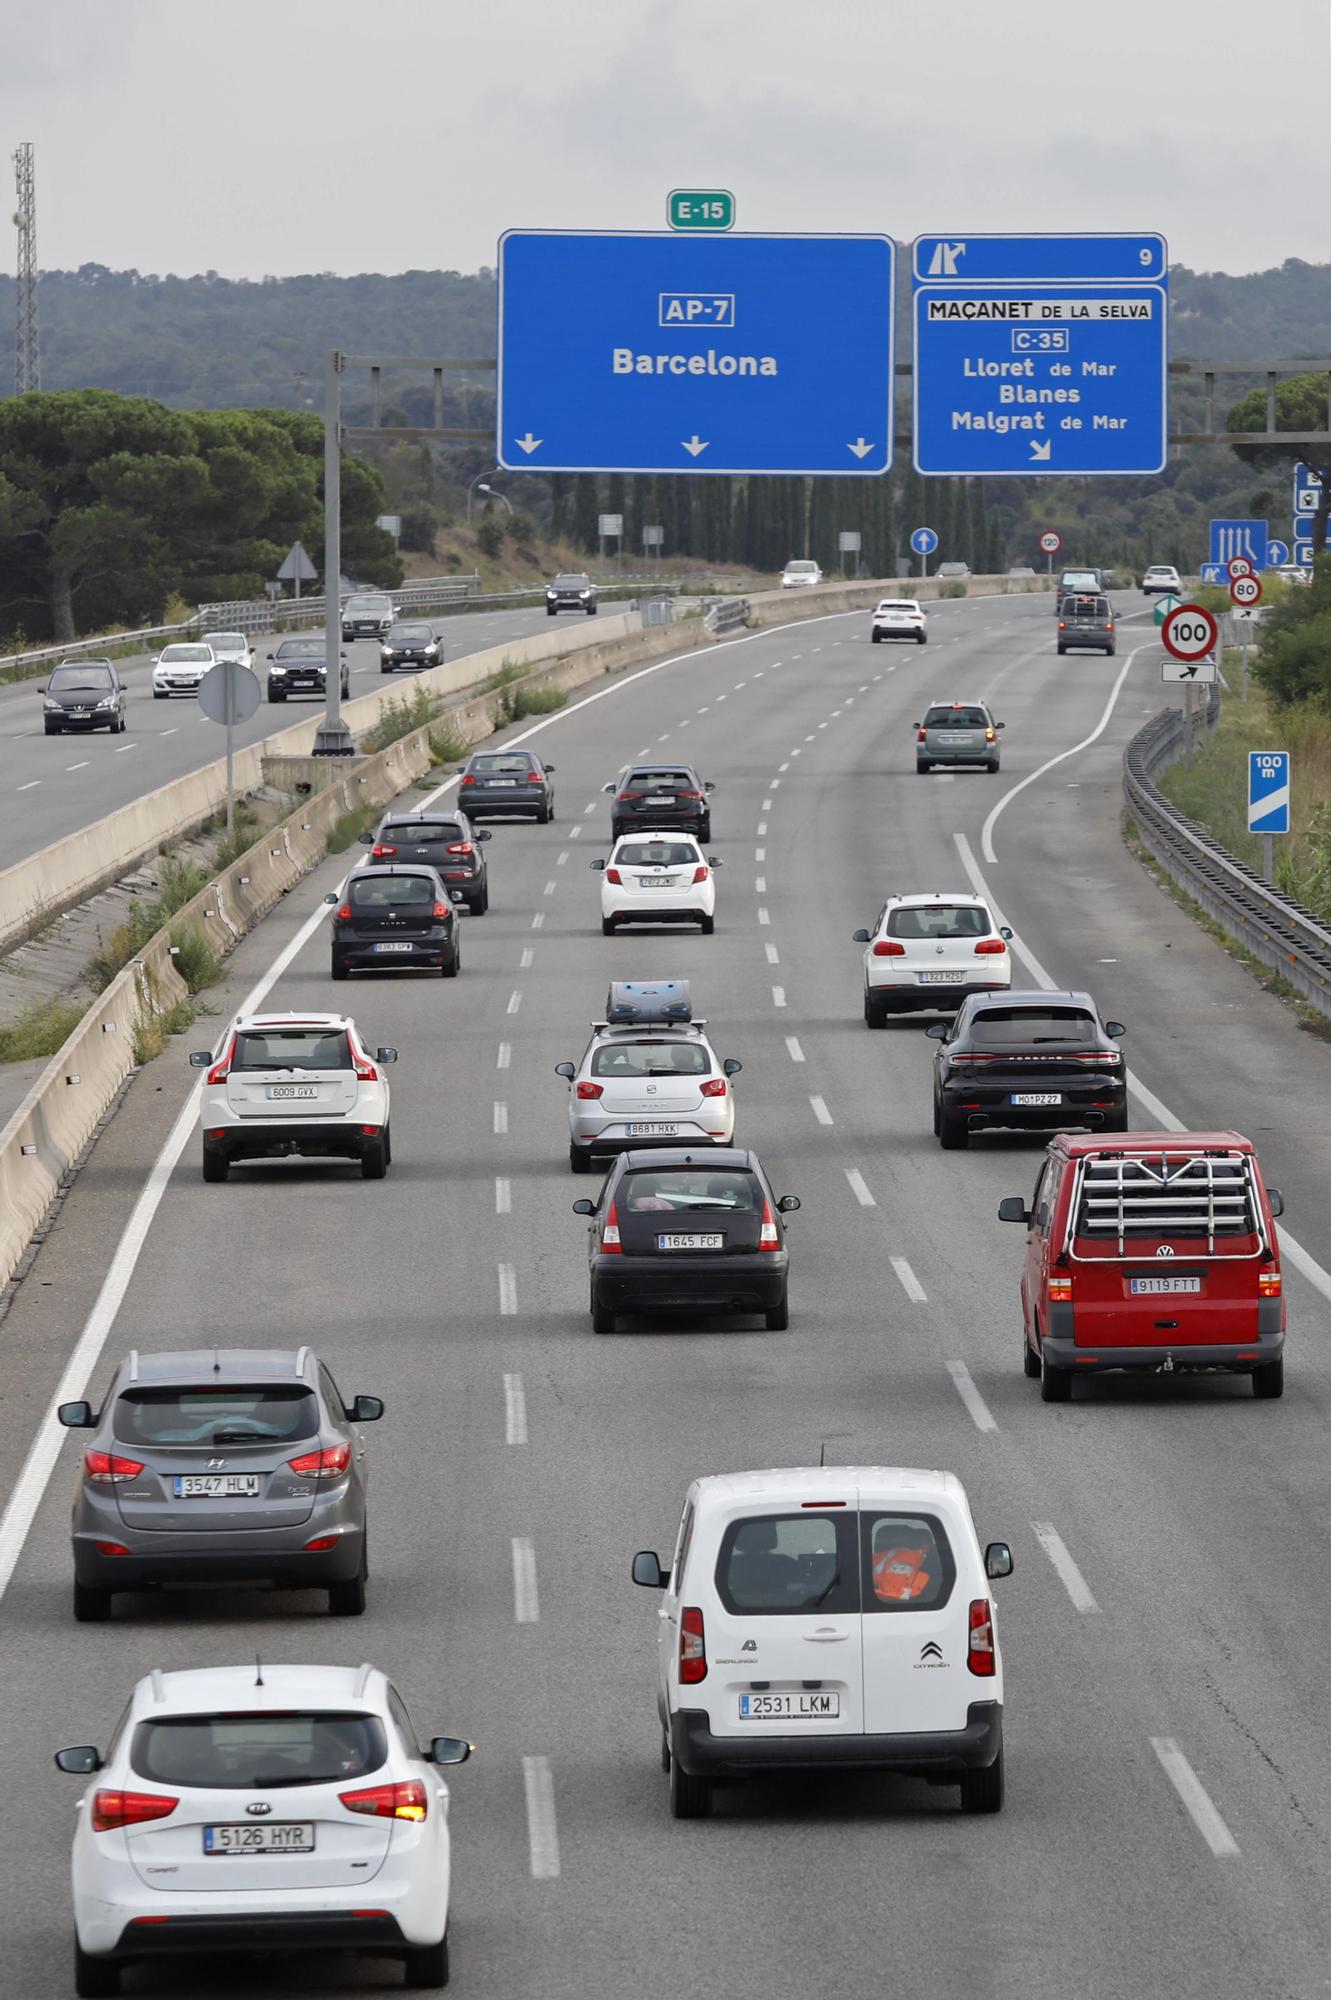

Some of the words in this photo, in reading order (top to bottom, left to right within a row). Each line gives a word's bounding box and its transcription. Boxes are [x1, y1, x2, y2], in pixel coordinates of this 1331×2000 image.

[678, 201, 724, 219] E-15
[1139, 248, 1152, 266] 9
[665, 300, 729, 321] AP-7
[930, 301, 1033, 321] MAÇANET
[1042, 306, 1062, 318] DE
[1070, 306, 1090, 318] LA
[1099, 305, 1149, 318] SELVA
[1016, 333, 1064, 349] C-35
[613, 348, 778, 376] Barcelona
[963, 358, 1034, 377] Lloret
[1049, 363, 1071, 376] de
[1082, 362, 1116, 376] Mar
[999, 385, 1080, 403] Blanes
[952, 411, 1044, 433] Malgrat
[1060, 416, 1082, 429] de
[1093, 416, 1127, 430] Mar
[1231, 564, 1247, 574] 60
[1236, 584, 1255, 595] 80
[1172, 623, 1206, 642] 100
[1255, 756, 1282, 768] 100
[1261, 768, 1276, 778] m
[273, 1088, 295, 1097] 6009
[297, 1087, 314, 1096] GVX
[632, 1124, 654, 1133] 8681
[658, 1124, 676, 1133] HXK
[668, 1236, 694, 1247] 1645
[701, 1236, 720, 1247] FCF
[1139, 1280, 1169, 1292] 9119
[1173, 1279, 1196, 1291] FTT
[185, 1478, 222, 1492] 3547
[227, 1477, 256, 1490] HLM
[753, 1697, 791, 1713] 2531
[800, 1696, 830, 1712] LKM
[219, 1829, 263, 1847] 5126
[271, 1828, 304, 1846] HYR
